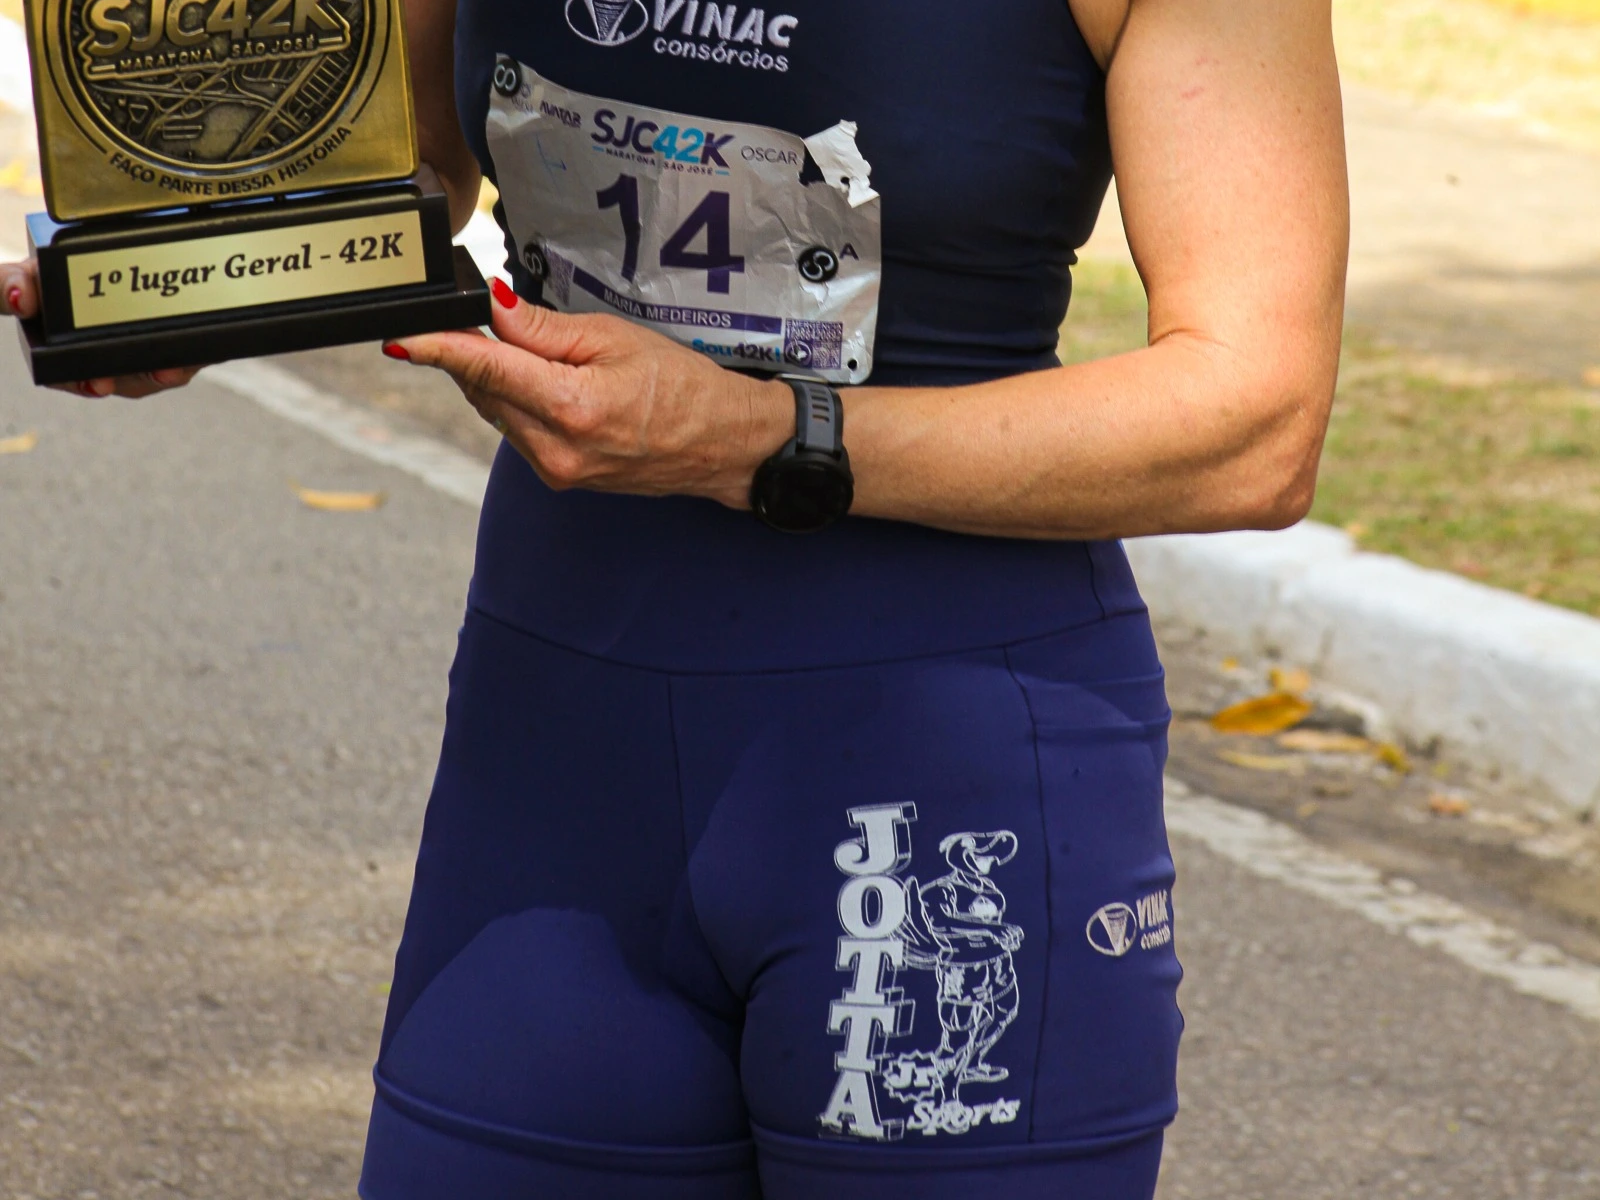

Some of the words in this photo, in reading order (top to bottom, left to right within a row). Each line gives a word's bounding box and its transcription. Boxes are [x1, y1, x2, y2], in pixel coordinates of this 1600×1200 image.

[120, 48, 214, 71] MARATONA
[653, 36, 789, 73] consórcios
[591, 109, 736, 169] SJC42K
[605, 147, 656, 167] MARATONA
[740, 145, 799, 166] OSCAR
[110, 152, 156, 184] FAÇO
[160, 176, 213, 196] PARTE
[218, 174, 275, 196] DESSA
[278, 125, 353, 182] HISTÓRIA
[596, 172, 745, 294] 14
[130, 263, 217, 297] lugar
[224, 243, 313, 280] Geral
[339, 231, 404, 264] 42K
[603, 287, 643, 317] MARIA
[646, 304, 733, 329] MEDEIROS
[816, 801, 917, 1141] JOTTA
[905, 1097, 1022, 1137] Sports
